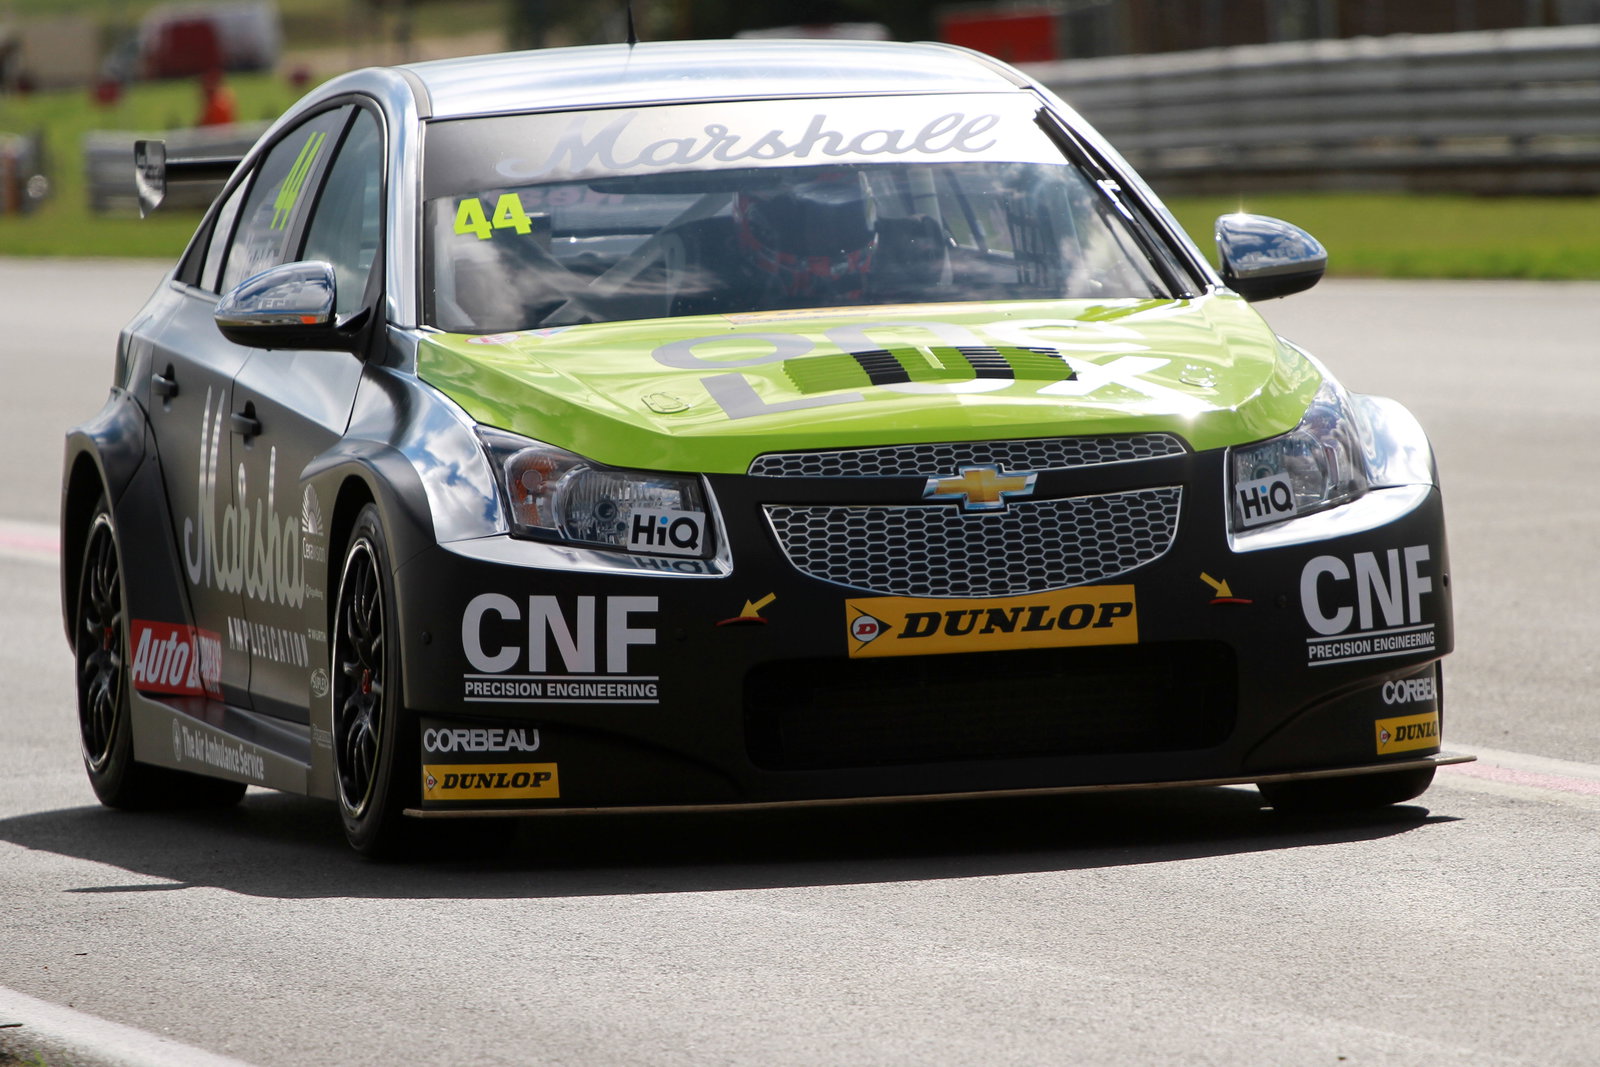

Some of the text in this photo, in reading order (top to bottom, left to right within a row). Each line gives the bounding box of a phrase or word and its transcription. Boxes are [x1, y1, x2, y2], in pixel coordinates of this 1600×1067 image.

[495, 110, 1001, 179] Marshall
[270, 131, 328, 231] 44
[453, 192, 533, 240] 44
[1239, 480, 1294, 520] HiQ
[631, 513, 699, 551] HiQ
[1299, 543, 1433, 636] CNF
[227, 615, 310, 668] AMPLIFICATION
[461, 592, 660, 674] CNF
[896, 601, 1134, 640] DUNLOP
[131, 627, 190, 687] Auto
[1307, 630, 1436, 660] PRECISION ENGINEERING
[464, 681, 659, 698] PRECISION ENGINEERING
[182, 725, 265, 781] The Air Ambulance Service
[422, 727, 541, 753] CORBEAU
[440, 770, 553, 790] DUNLOP
